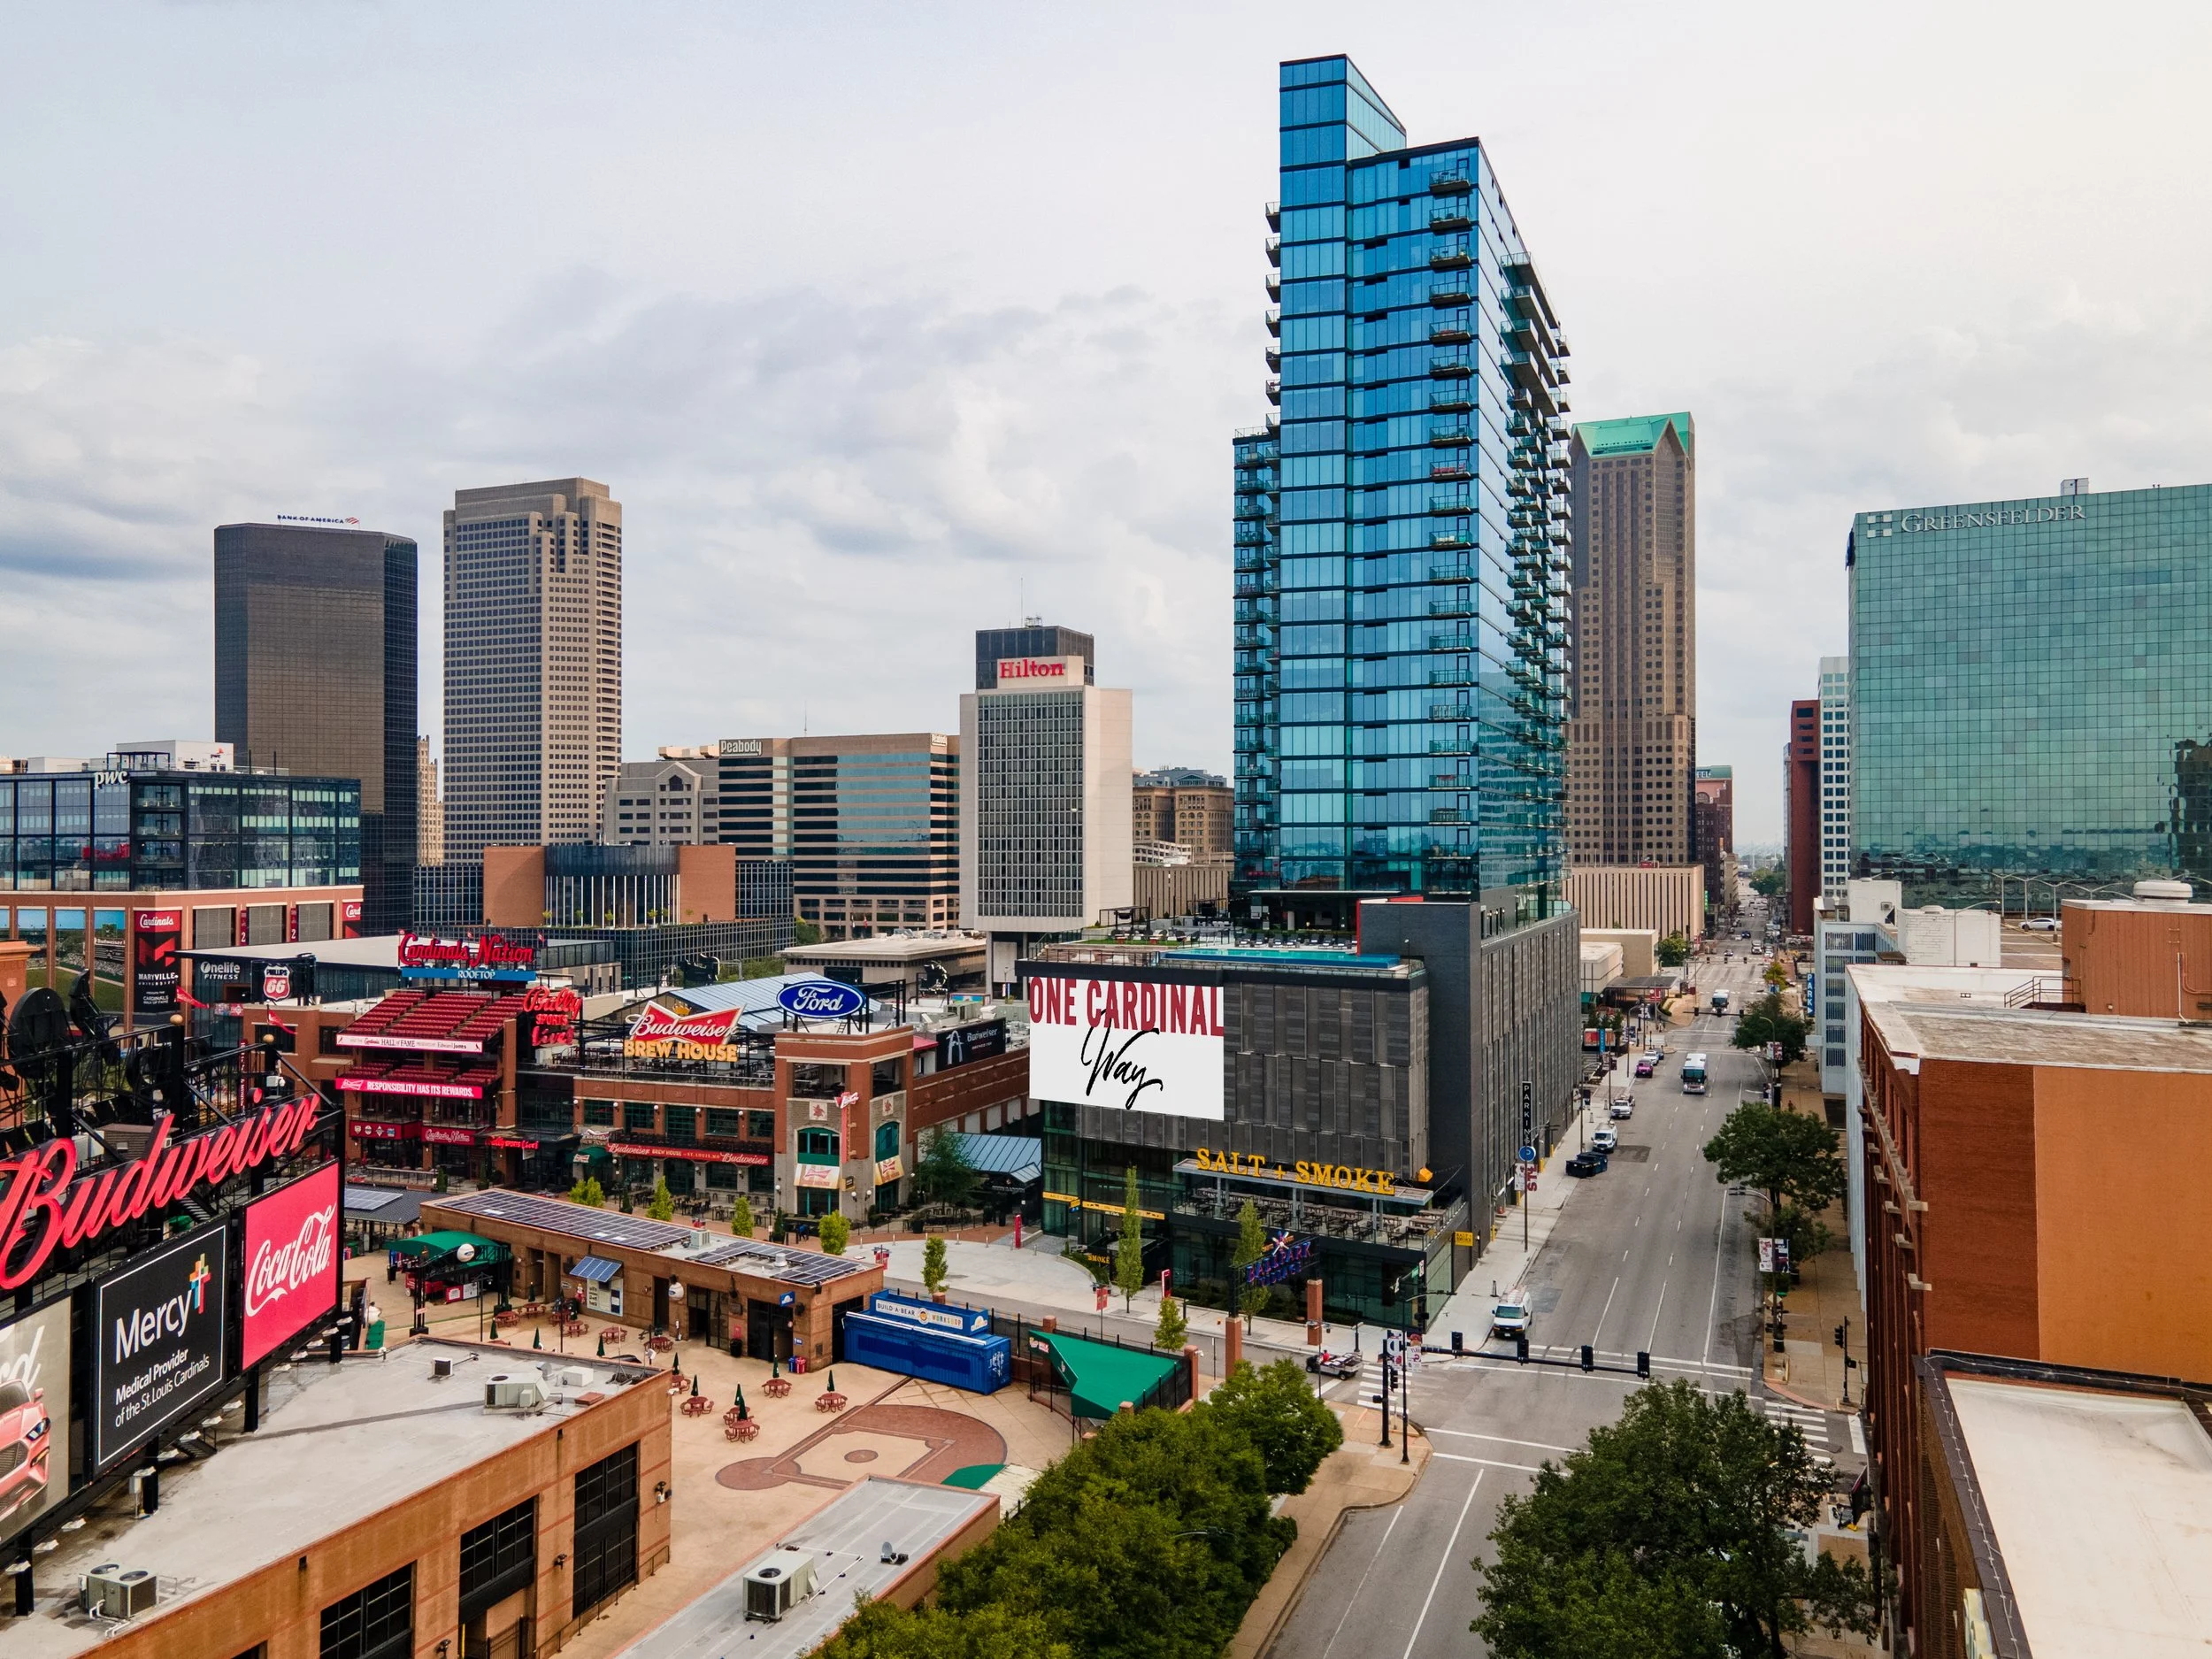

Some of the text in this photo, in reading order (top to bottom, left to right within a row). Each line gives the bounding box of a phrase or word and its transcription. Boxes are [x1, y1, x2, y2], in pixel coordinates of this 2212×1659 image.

[1901, 505, 2085, 533] GREENSFELDER
[1000, 658, 1064, 679] Hilton
[720, 740, 762, 757] Peabody
[94, 770, 128, 789] pwc
[140, 913, 174, 929] Cardinals
[399, 933, 534, 968] Cardinals Nation
[138, 972, 175, 980] MARYVILLE
[457, 970, 495, 980] ROOFTOP
[266, 979, 287, 994] 66
[523, 985, 582, 1020] Bally
[793, 987, 844, 1012] Ford
[1029, 976, 1225, 1037] ONE CARDINAL
[535, 1013, 568, 1026] SPORTS
[625, 1013, 738, 1038] Budweiser
[380, 1038, 396, 1047] HALL
[533, 1026, 575, 1047] Live!
[624, 1040, 738, 1062] BREW HOUSE
[1080, 1007, 1164, 1110] Way
[366, 1081, 416, 1094] RESPONSIBILITY
[417, 1085, 431, 1094] HAS
[431, 1086, 442, 1095] ITS
[442, 1087, 474, 1097] REWARDS.
[607, 1143, 650, 1156] Budweiser
[719, 1151, 769, 1165] Budweiser
[1196, 1147, 1396, 1195] SALT + SMOKE
[0, 1087, 321, 1290] Budweiser
[245, 1202, 336, 1317] Coca-Cola
[1087, 1253, 1110, 1264] SMOKE
[1247, 1241, 1311, 1283] BALLPARK
[115, 1288, 191, 1364] Mercy
[932, 1314, 962, 1326] WORKSHOP
[115, 1348, 188, 1405] Medical Provider
[115, 1354, 210, 1428] of the St. Louis Cardinals
